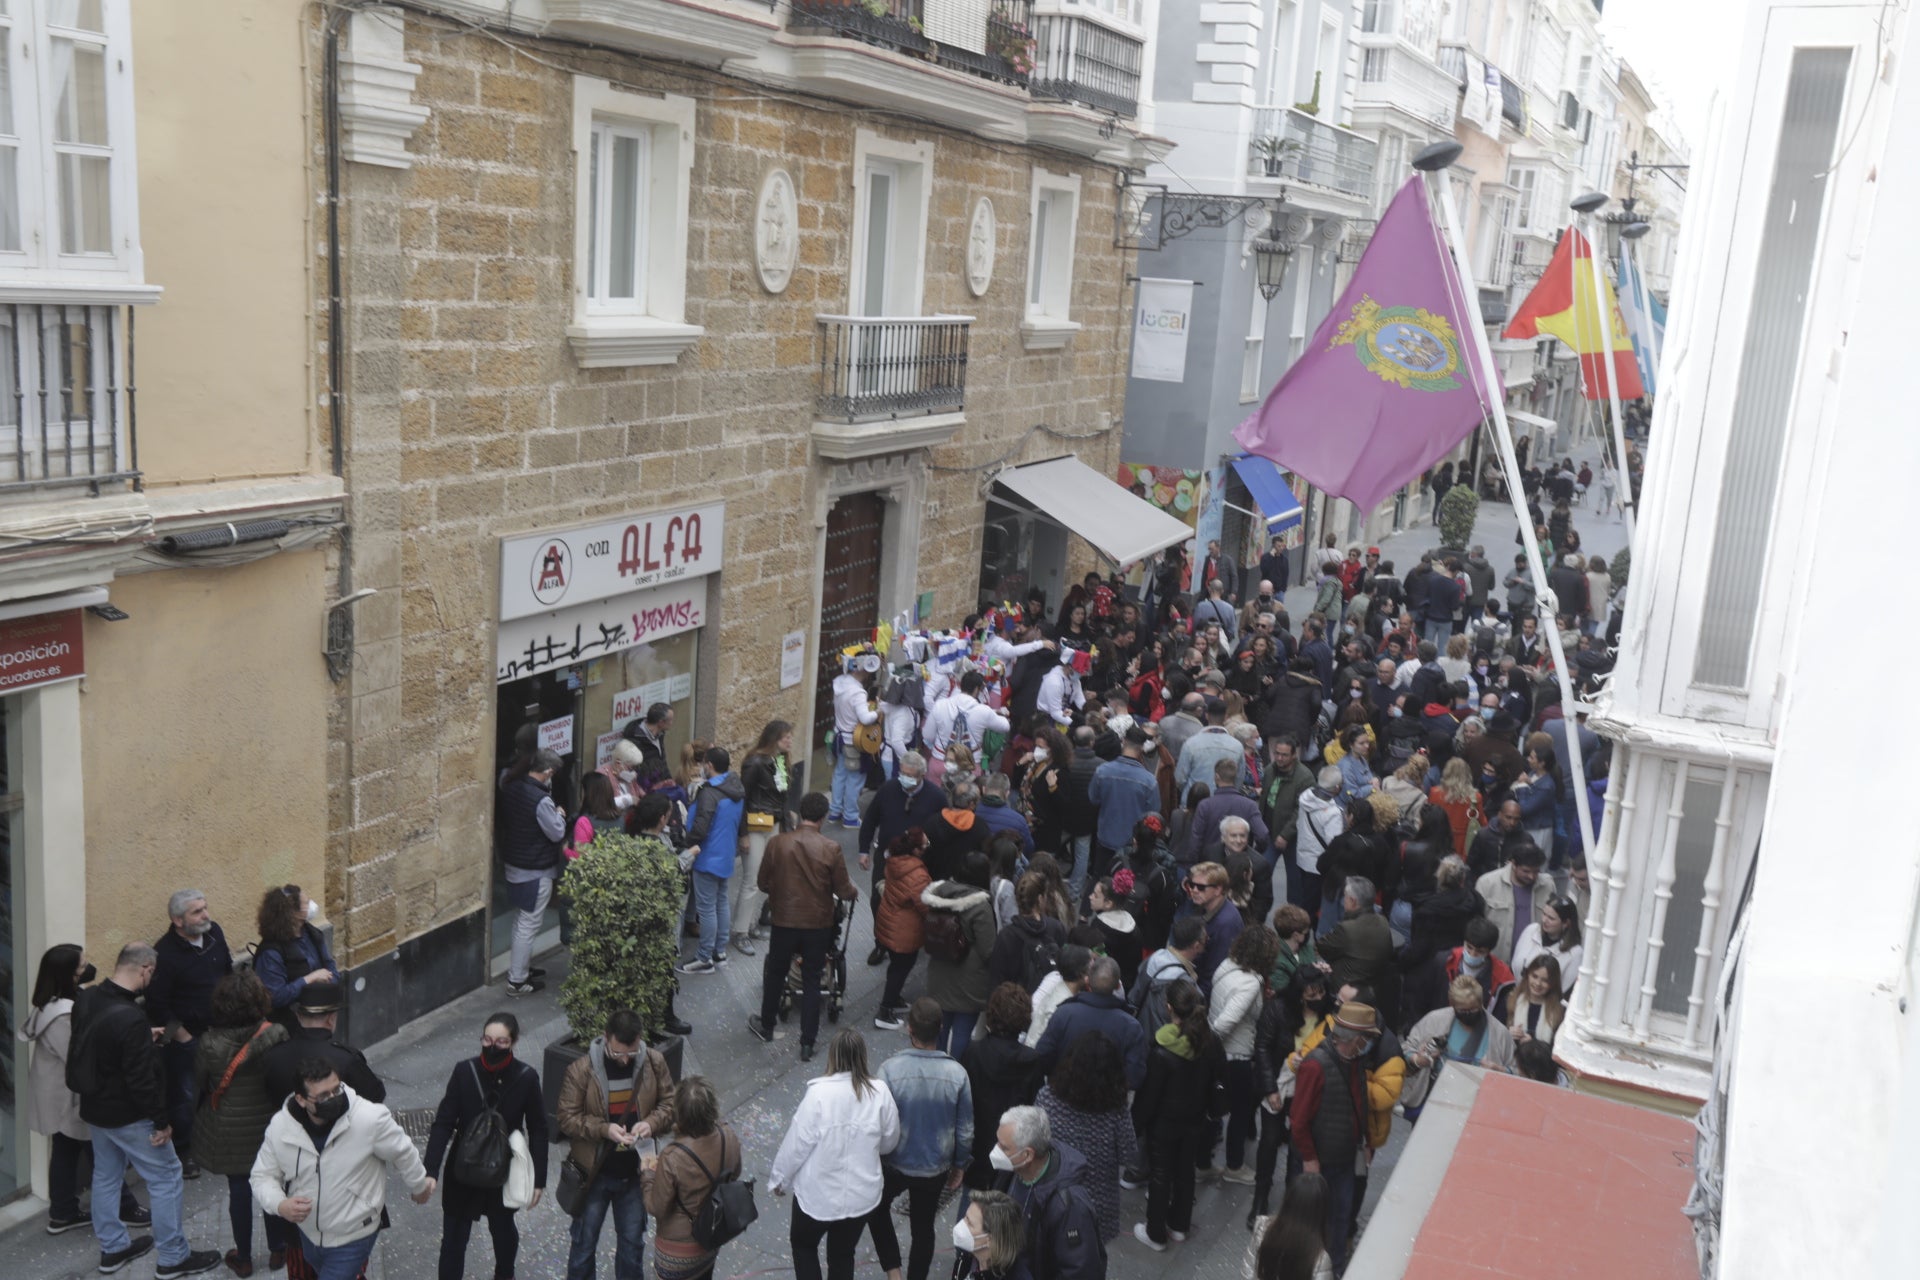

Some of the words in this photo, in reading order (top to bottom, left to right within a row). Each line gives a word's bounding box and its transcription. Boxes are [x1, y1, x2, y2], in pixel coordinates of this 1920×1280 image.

[585, 540, 610, 558] con
[618, 513, 702, 577] ALFA
[543, 578, 560, 590] ALFA
[655, 572, 661, 584] y
[615, 694, 641, 720] ALFA
